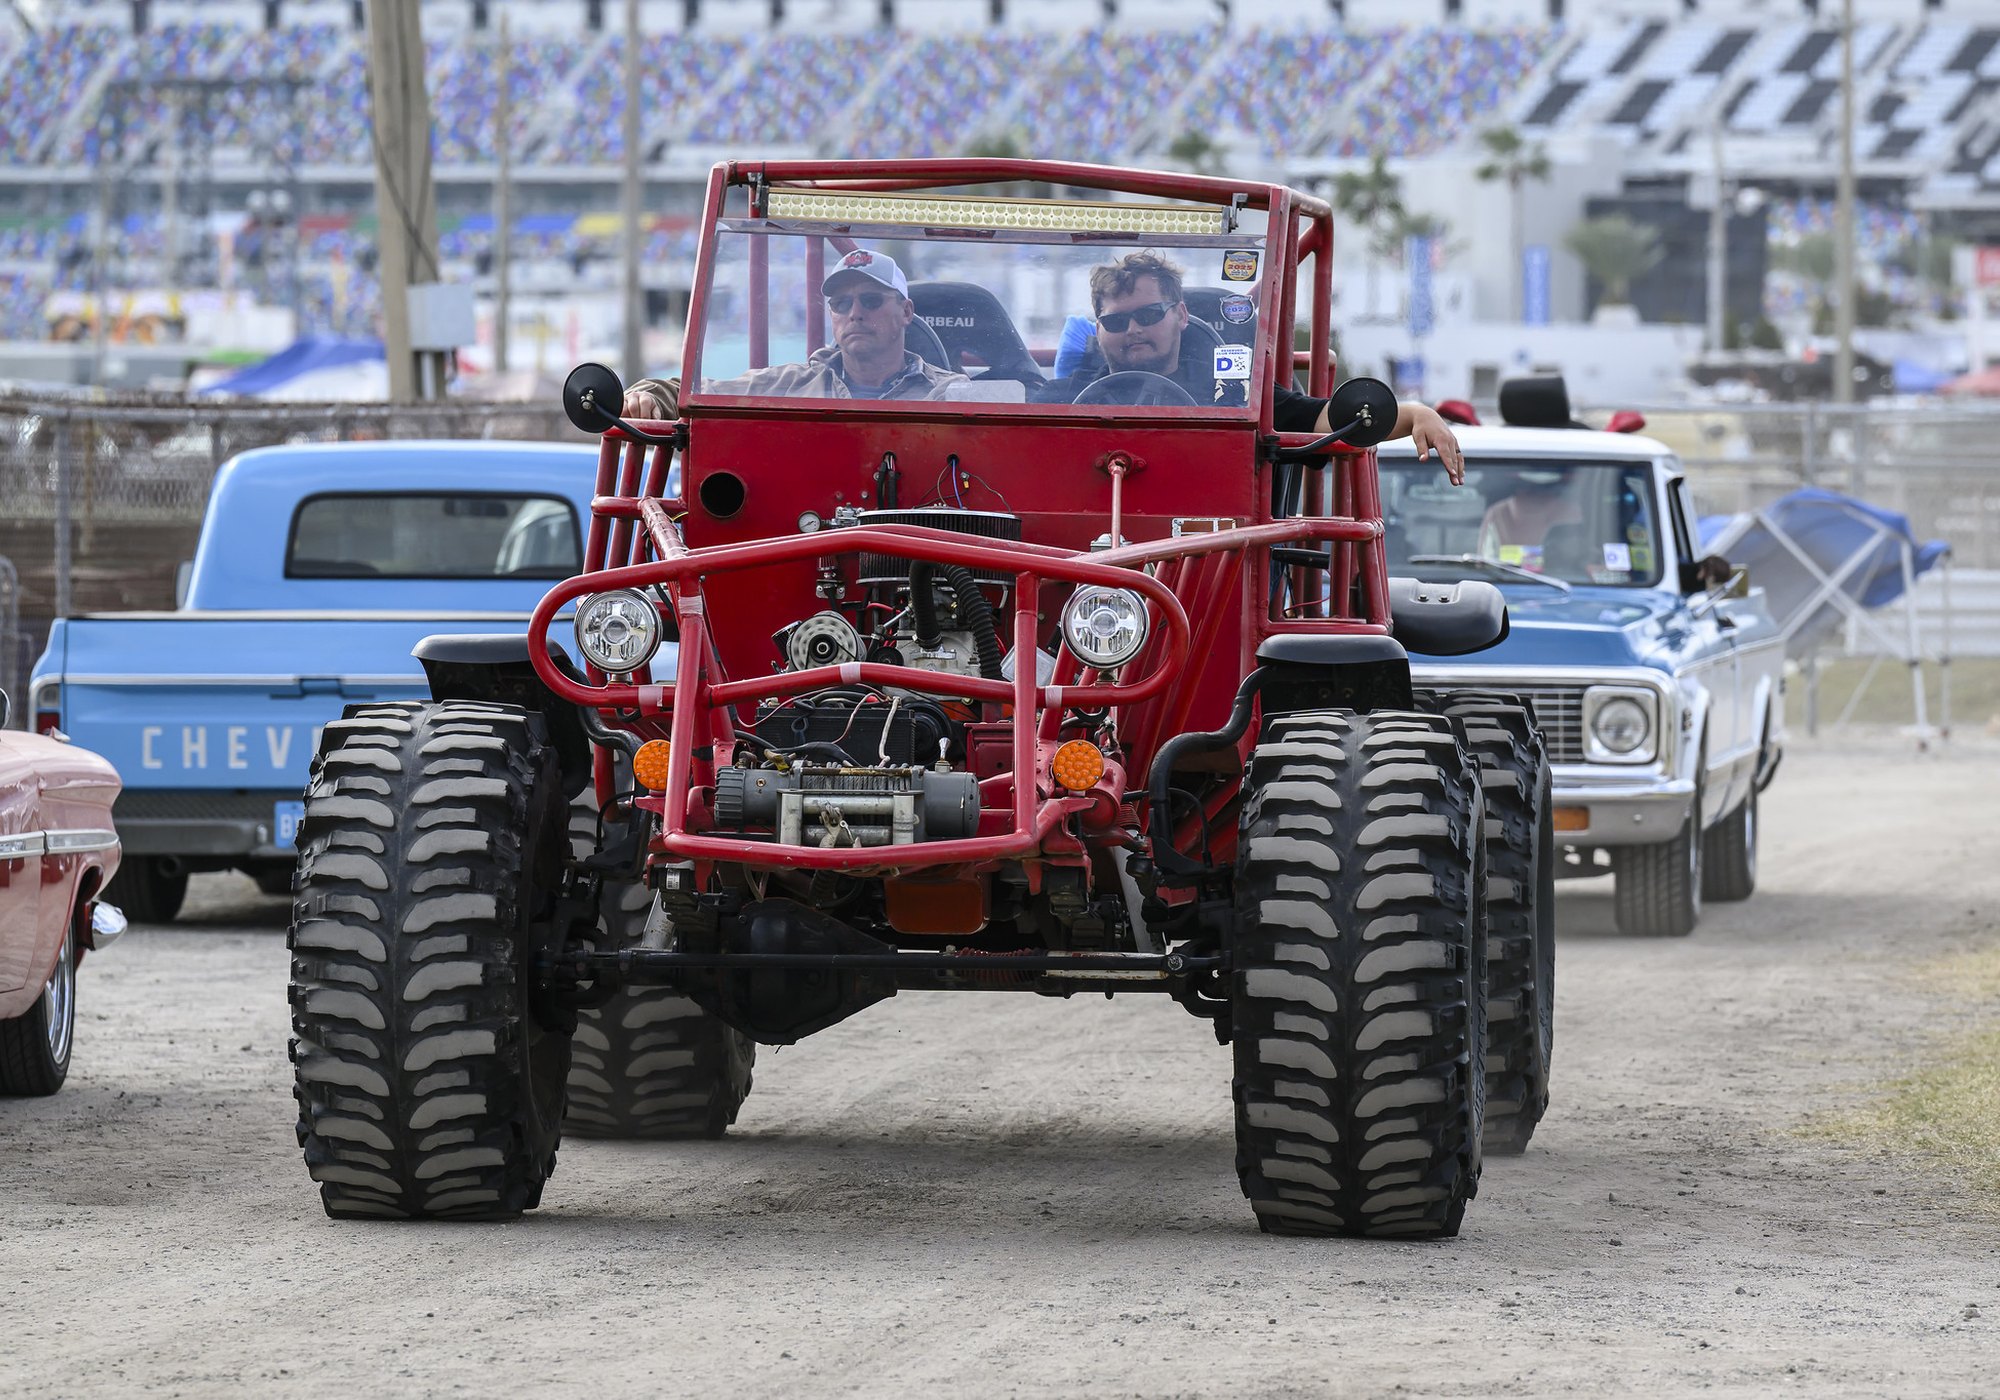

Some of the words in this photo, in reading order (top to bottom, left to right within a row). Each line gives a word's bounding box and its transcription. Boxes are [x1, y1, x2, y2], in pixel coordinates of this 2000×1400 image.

[921, 316, 975, 327] RBEAU
[1217, 357, 1233, 371] D
[142, 726, 321, 769] CHEV
